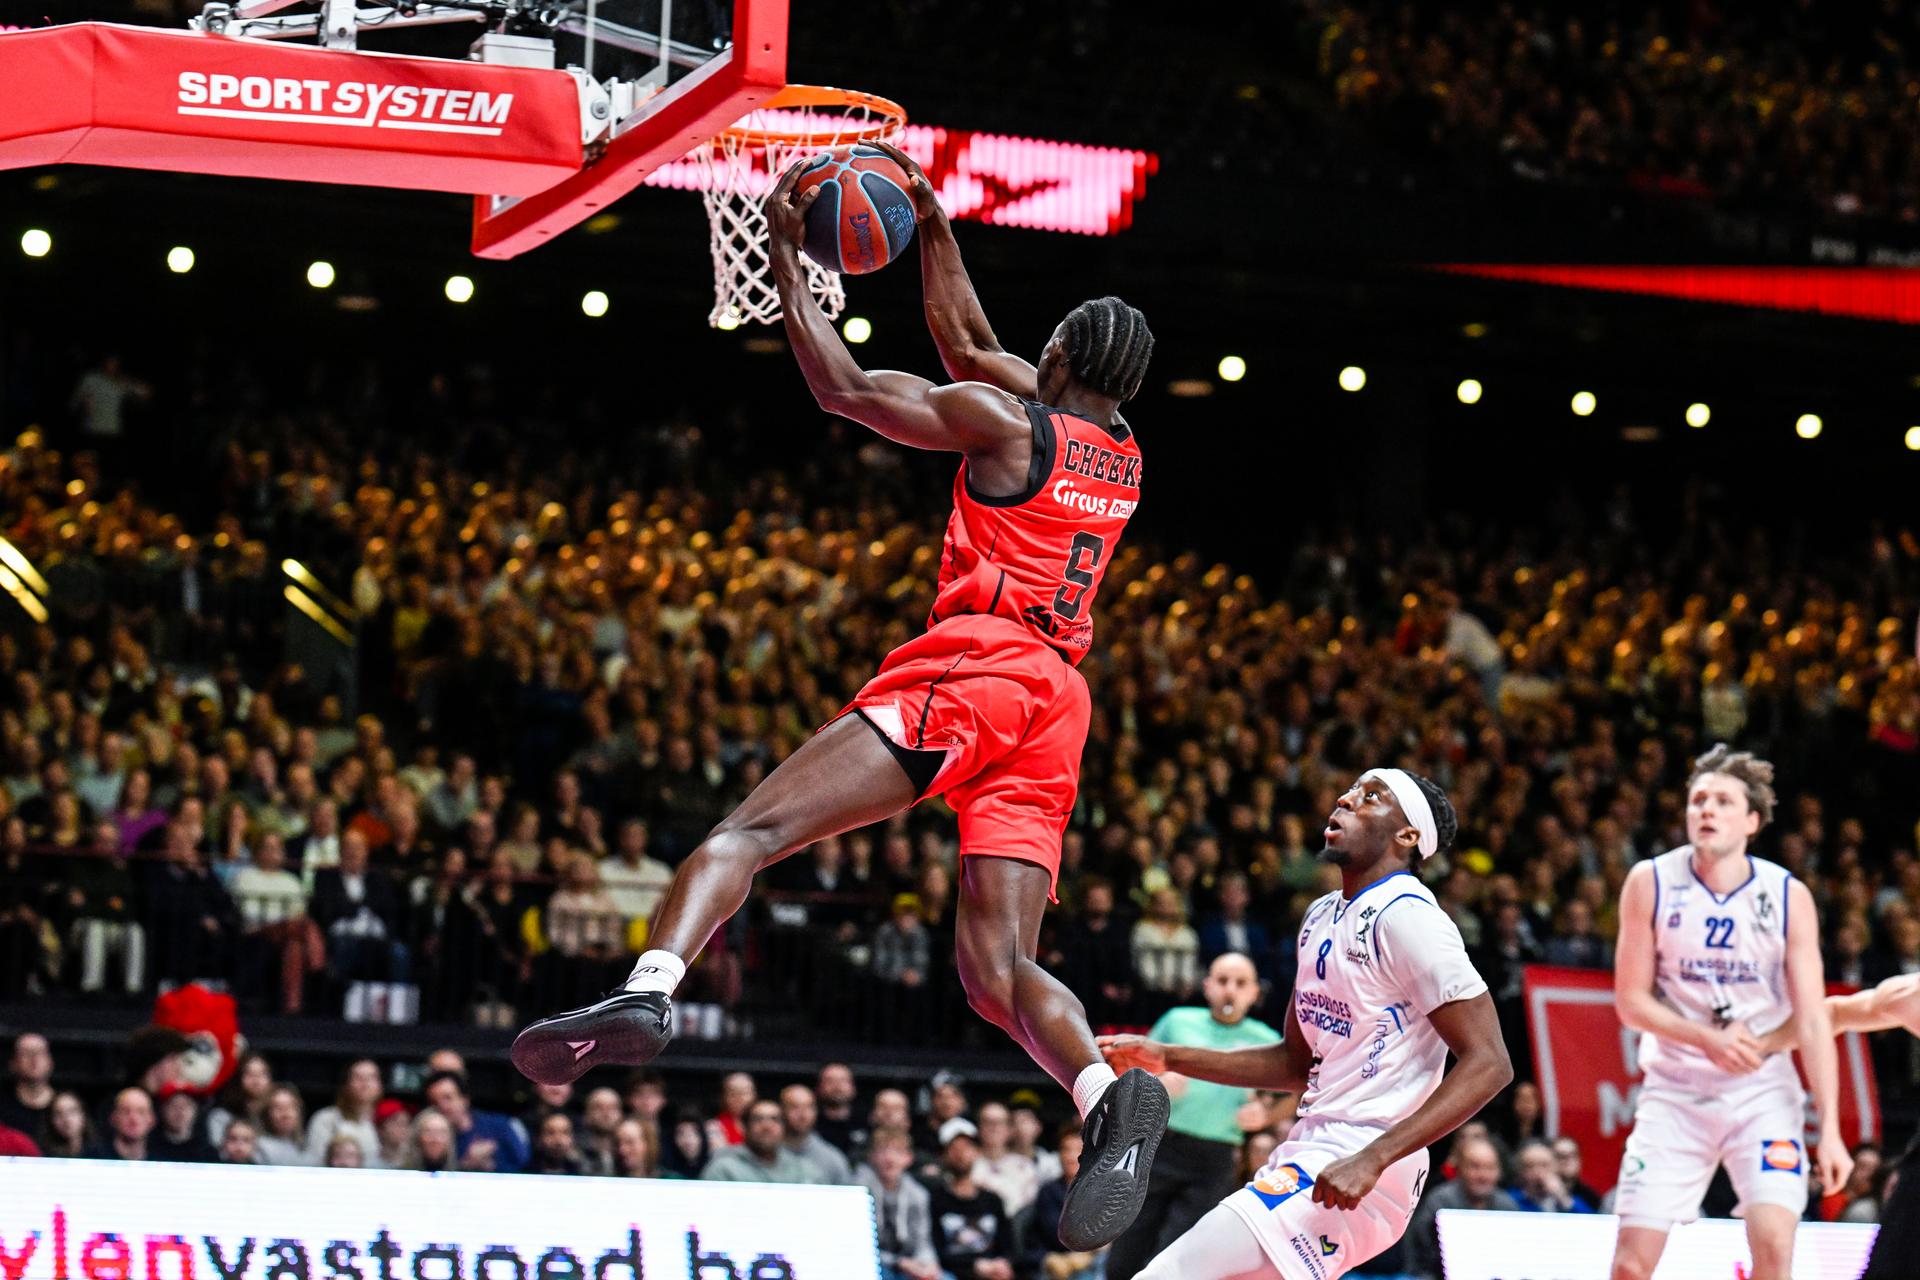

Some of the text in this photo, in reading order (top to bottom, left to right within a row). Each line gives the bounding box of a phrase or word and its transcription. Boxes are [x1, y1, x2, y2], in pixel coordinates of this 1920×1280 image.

[177, 71, 514, 127] SPORT SYSTEM
[1062, 438, 1142, 489] CHEEK
[1053, 479, 1108, 515] Circus
[1051, 530, 1105, 622] 5
[1705, 916, 1735, 949] 22
[1316, 938, 1333, 981] 8
